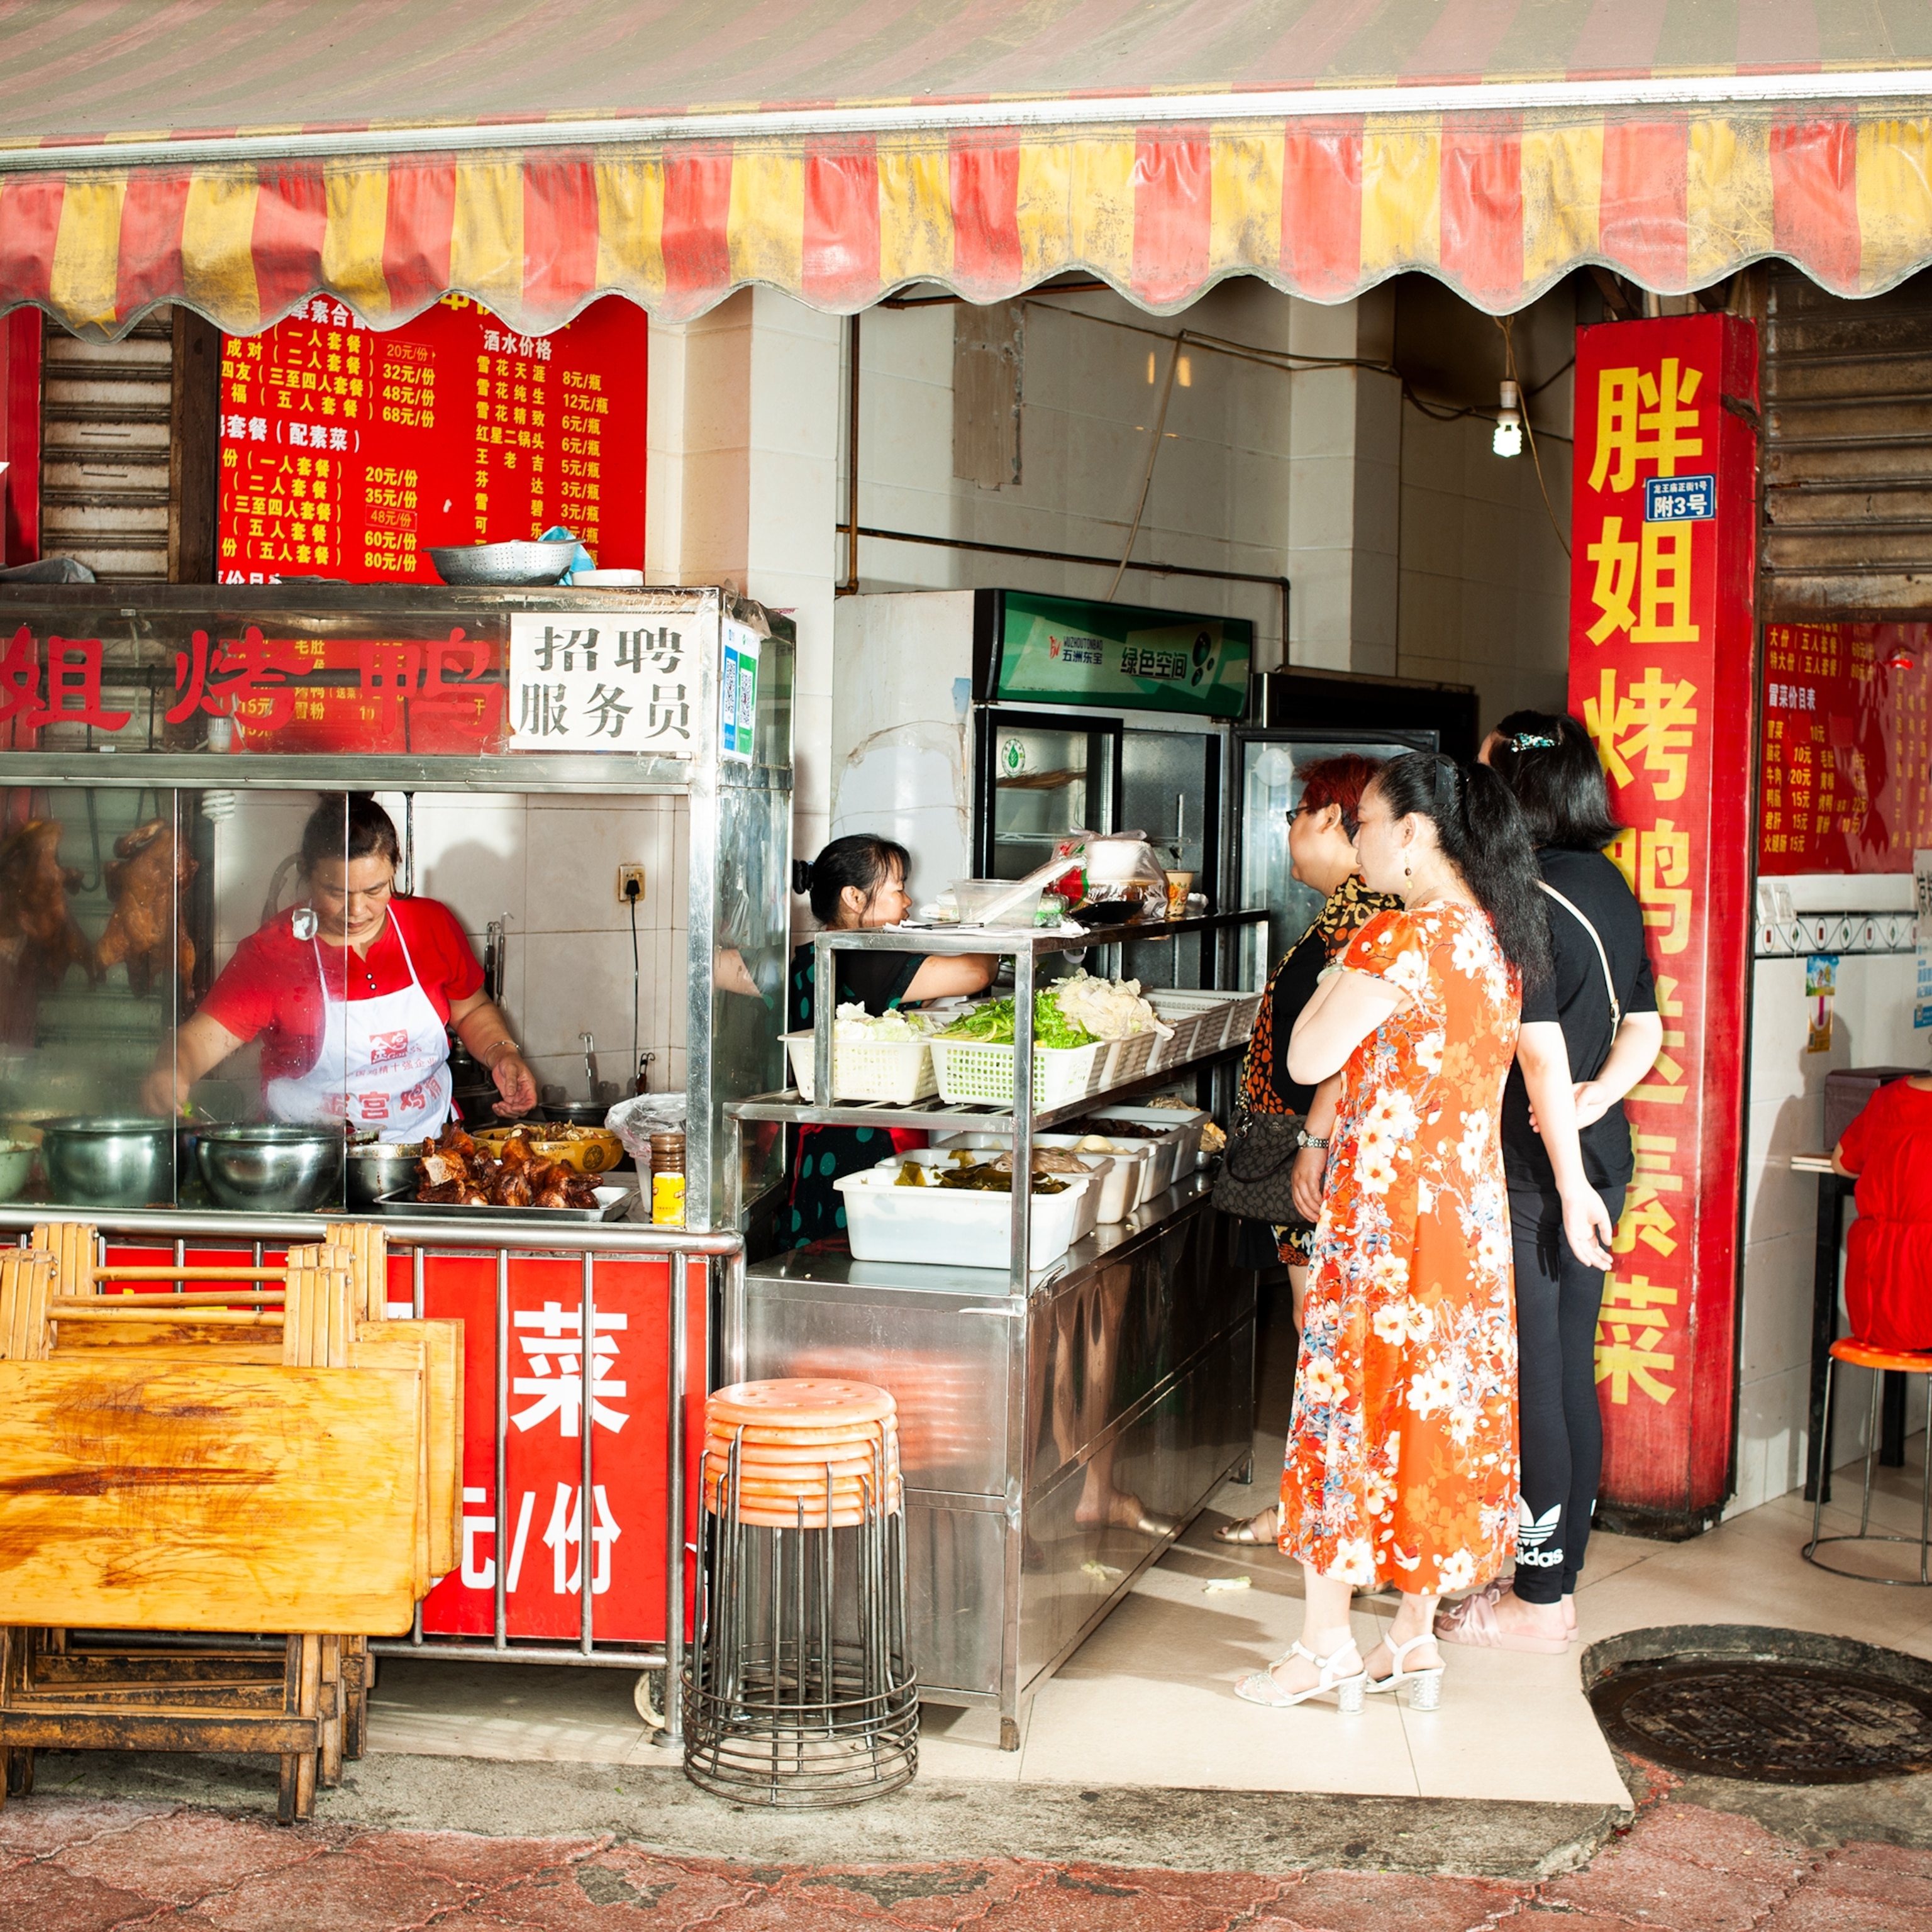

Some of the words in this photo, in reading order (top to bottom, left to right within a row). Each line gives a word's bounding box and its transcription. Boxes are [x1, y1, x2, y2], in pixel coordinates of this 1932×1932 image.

[387, 343, 428, 362] 20元/份
[483, 329, 552, 361] 酒水价格
[383, 363, 435, 386] 32元/份
[477, 355, 546, 382] 雪花天涯
[562, 371, 602, 391] 8元/瓶
[221, 382, 374, 420] 福（五人套餐）
[382, 406, 435, 428] 68元/份
[383, 385, 435, 407] 48元/份
[476, 378, 545, 406] 雪花纯生
[564, 394, 609, 414] 12元/瓶
[476, 401, 545, 428] 雪花精致
[562, 415, 601, 435] 6元/瓶
[475, 425, 545, 450] 红星二锅头
[562, 438, 601, 457] 6元/瓶
[365, 467, 418, 487] 20元/份
[562, 460, 600, 479] 5元/瓶
[365, 488, 418, 509] 35元/份
[561, 482, 600, 501] 3元/瓶
[561, 504, 599, 523] 3元/瓶
[1654, 494, 1708, 518] 附3号
[371, 510, 411, 528] 48元/份
[365, 531, 417, 551] 60元/份
[562, 526, 599, 544] 元/瓶
[365, 552, 417, 572] 80元/份
[535, 626, 685, 674] 招聘
[1062, 649, 1102, 665] 五洲东宝
[1120, 647, 1188, 679] 绿色空间
[1769, 683, 1816, 711] 冒菜价目表
[519, 682, 691, 740] 服务员
[1794, 746, 1811, 764] 10元
[1790, 769, 1811, 786] 20元
[1792, 791, 1810, 809] 15元
[347, 1057, 436, 1076] 国鸡精十强企业
[511, 1301, 630, 1437] 菜
[1515, 1546, 1564, 1567] idas
